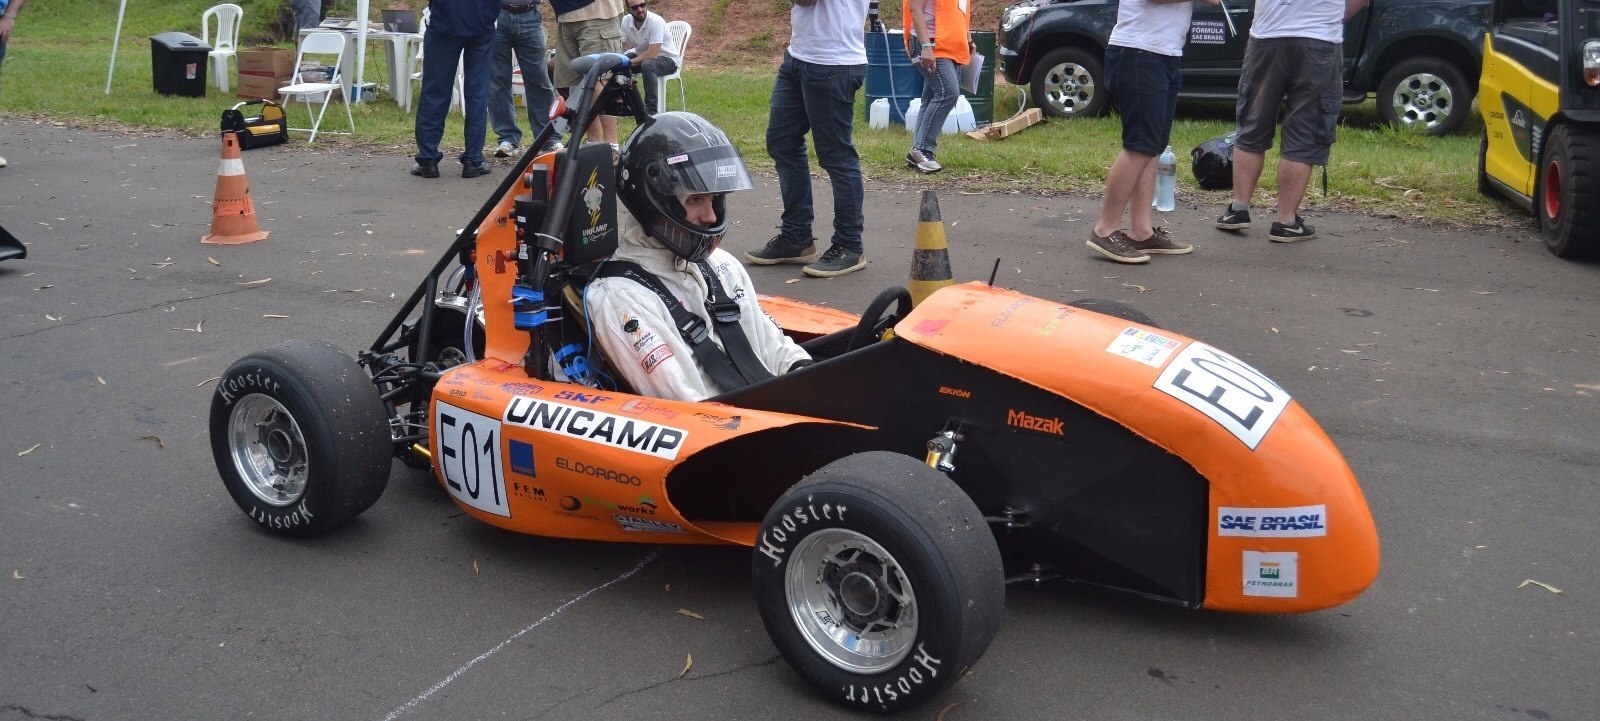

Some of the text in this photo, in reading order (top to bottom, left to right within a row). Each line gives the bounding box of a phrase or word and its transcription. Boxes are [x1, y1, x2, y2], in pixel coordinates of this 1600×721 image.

[218, 368, 280, 405] Hoosier
[553, 390, 613, 404] SKF
[1171, 347, 1282, 431] E01
[506, 398, 683, 454] UNICAMP
[1007, 409, 1065, 436] Mazak
[441, 412, 501, 506] E01
[556, 456, 642, 487] ELDORADO
[250, 499, 314, 529] Hoosier
[617, 503, 656, 516] works
[1220, 514, 1324, 531] SAE BRASIL
[759, 494, 847, 567] Hoosier
[1261, 567, 1278, 575] BR
[842, 641, 941, 709] Hoosier
